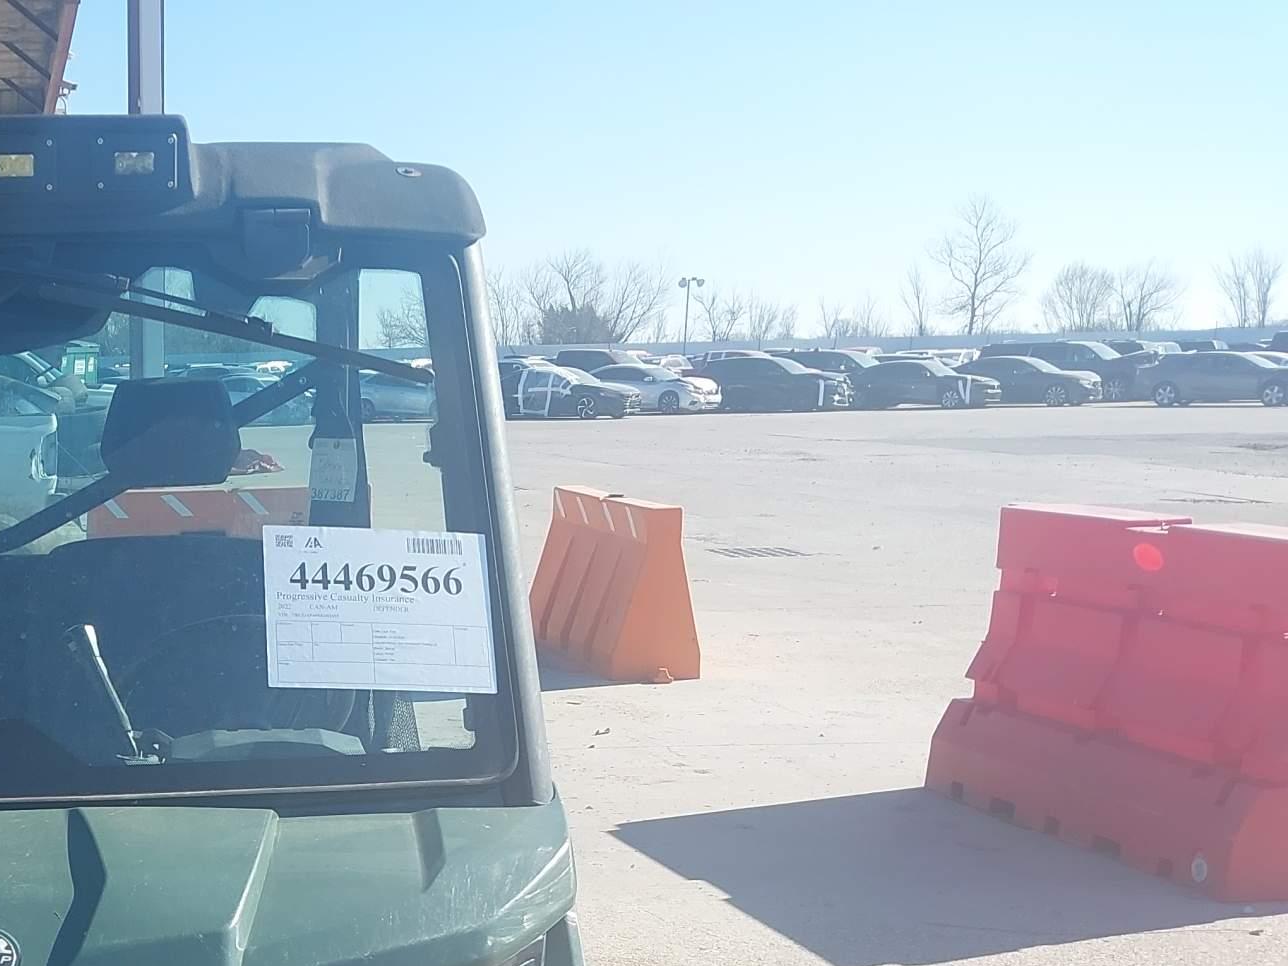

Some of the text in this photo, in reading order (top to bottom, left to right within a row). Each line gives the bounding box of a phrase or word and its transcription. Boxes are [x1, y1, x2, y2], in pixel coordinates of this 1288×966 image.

[289, 561, 463, 596] 44469566
[276, 591, 415, 604] Progressive Casualty Insurance
